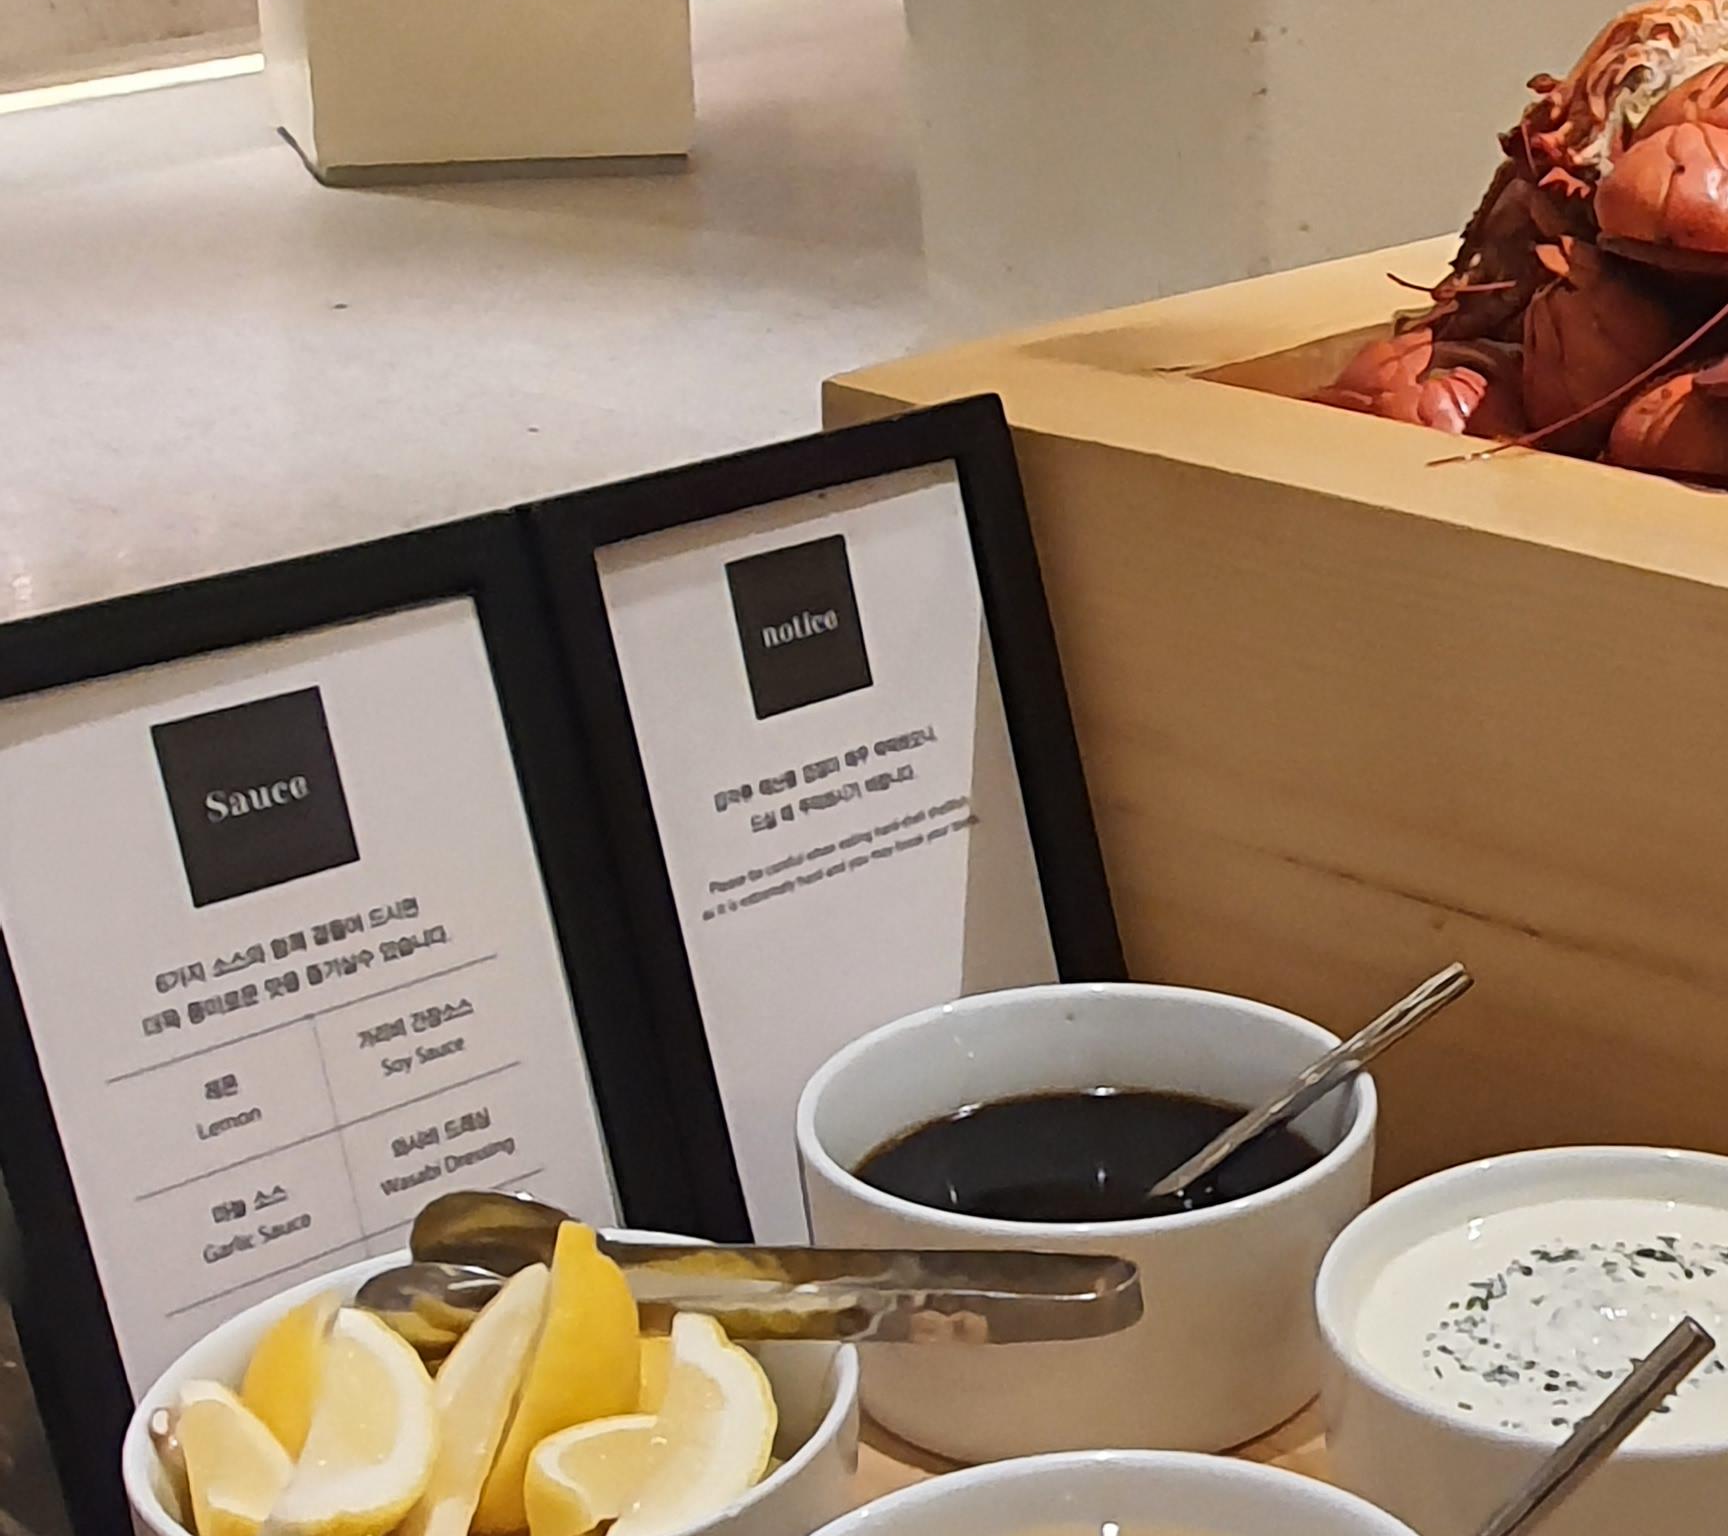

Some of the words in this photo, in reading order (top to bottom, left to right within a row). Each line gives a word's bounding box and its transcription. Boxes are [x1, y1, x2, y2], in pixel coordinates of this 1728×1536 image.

[762, 609, 839, 648] notice
[205, 775, 309, 823] Sauce
[381, 1056, 413, 1077] Soy
[415, 1037, 465, 1064] Sauce
[196, 1107, 262, 1141] Lemon
[258, 1214, 312, 1244] Sauce
